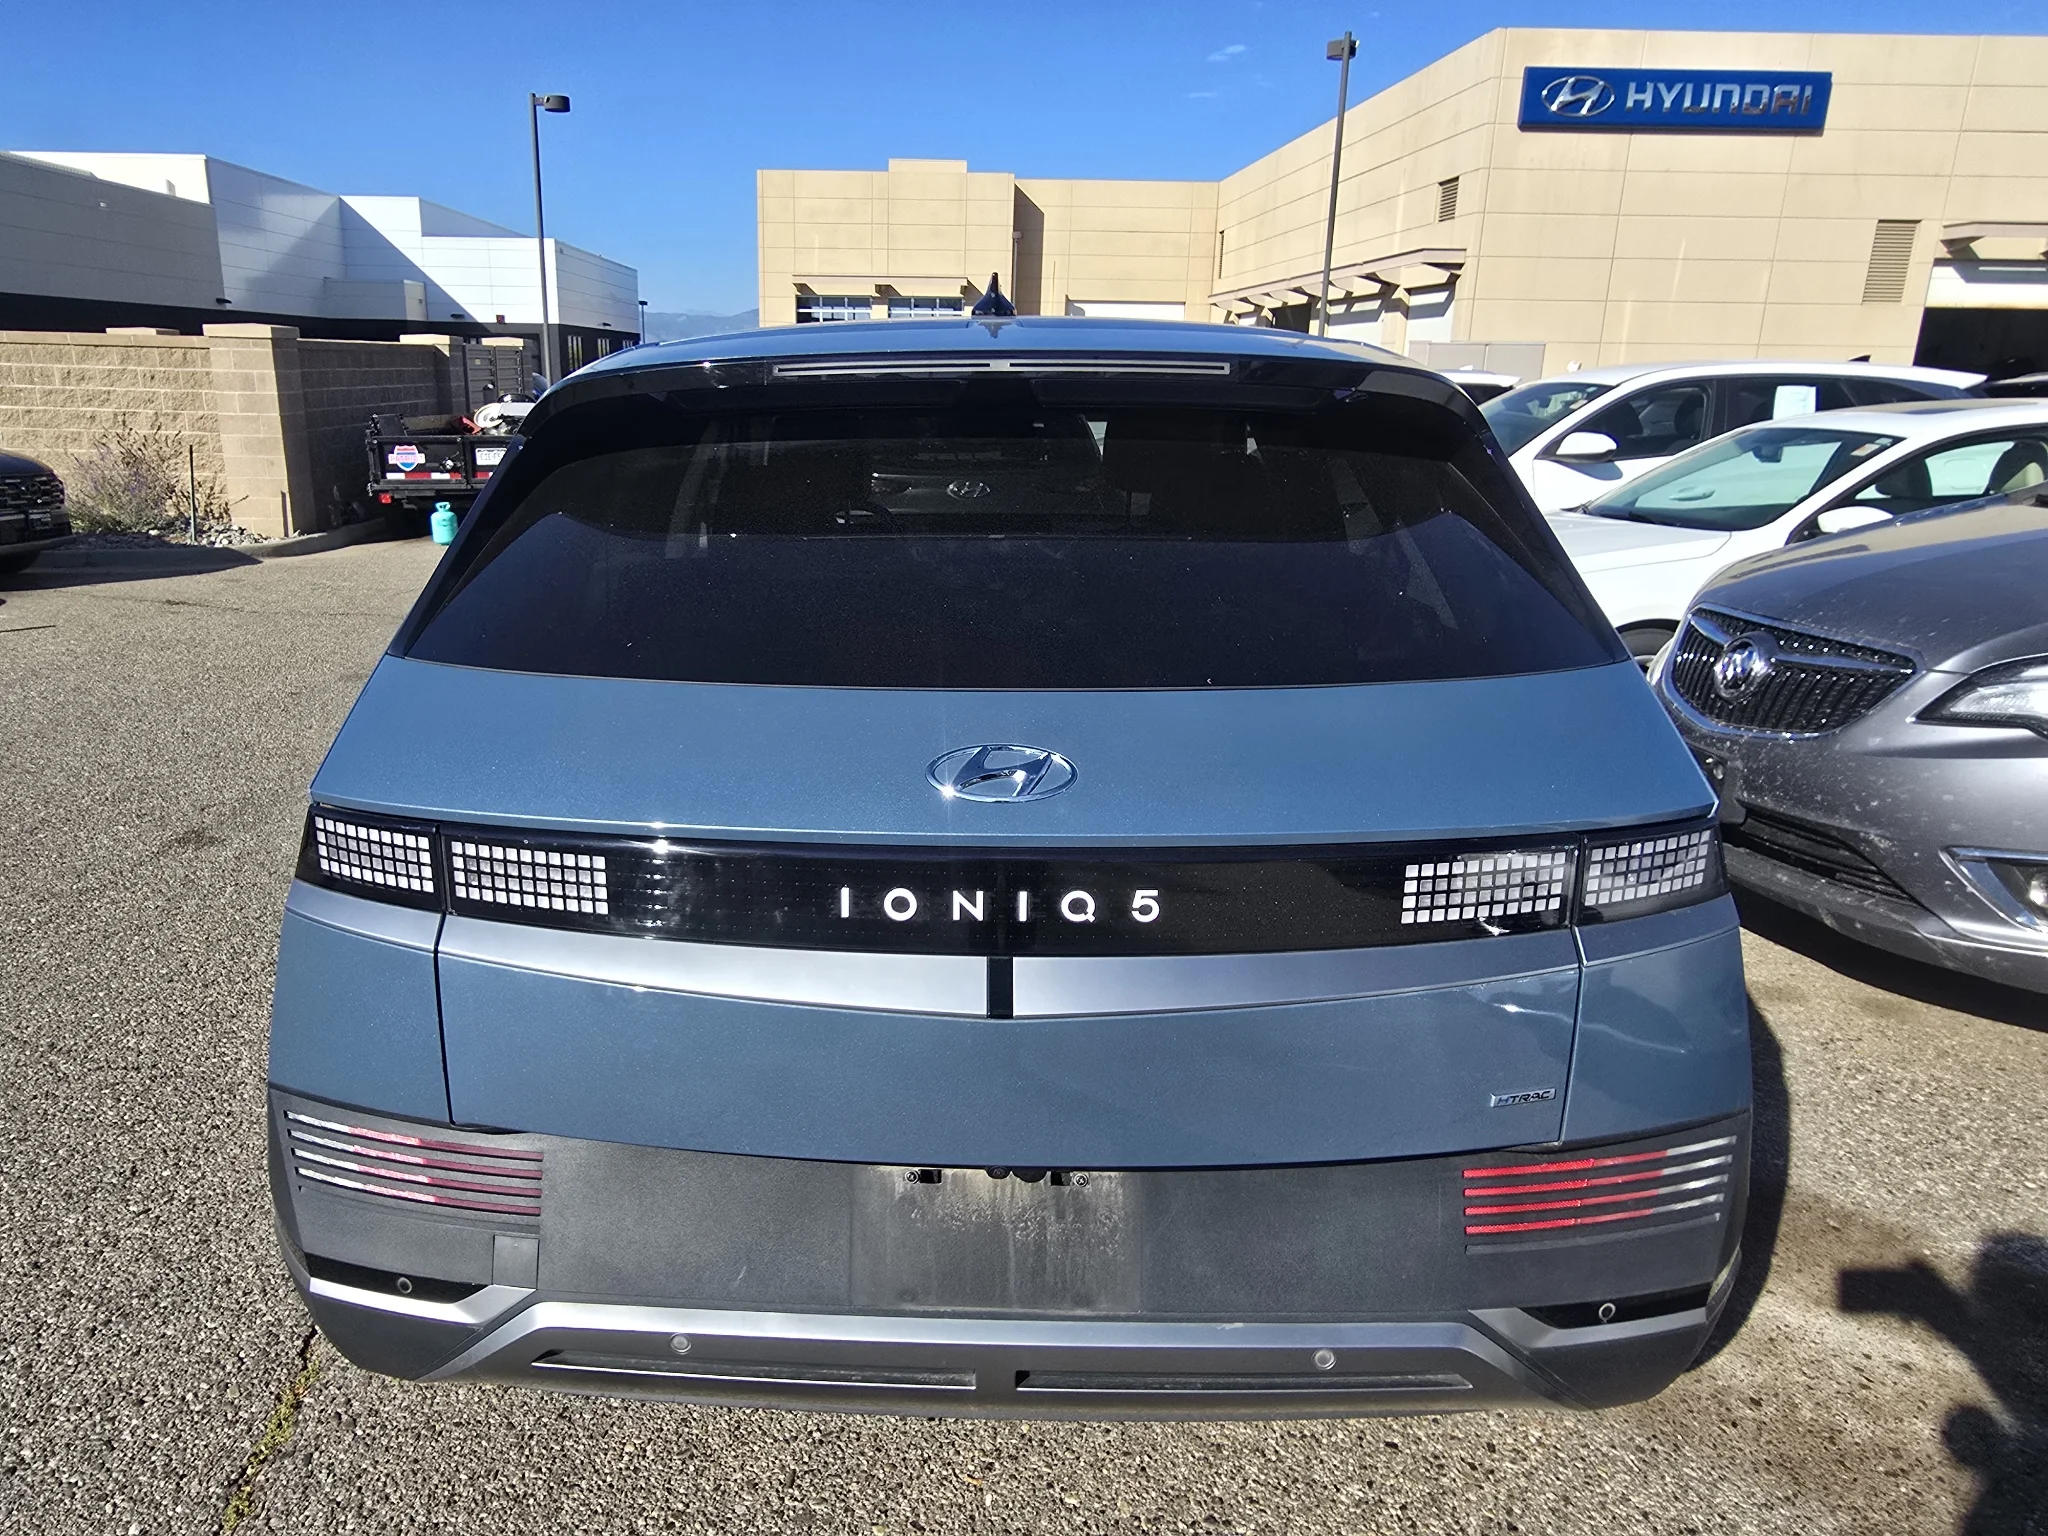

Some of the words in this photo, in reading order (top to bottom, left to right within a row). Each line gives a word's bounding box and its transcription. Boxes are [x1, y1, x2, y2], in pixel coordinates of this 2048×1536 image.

[1625, 81, 1813, 116] HYUNDAI
[839, 886, 1096, 923] IONIQ
[1131, 889, 1161, 923] 5
[1496, 1090, 1551, 1105] HTRAC
